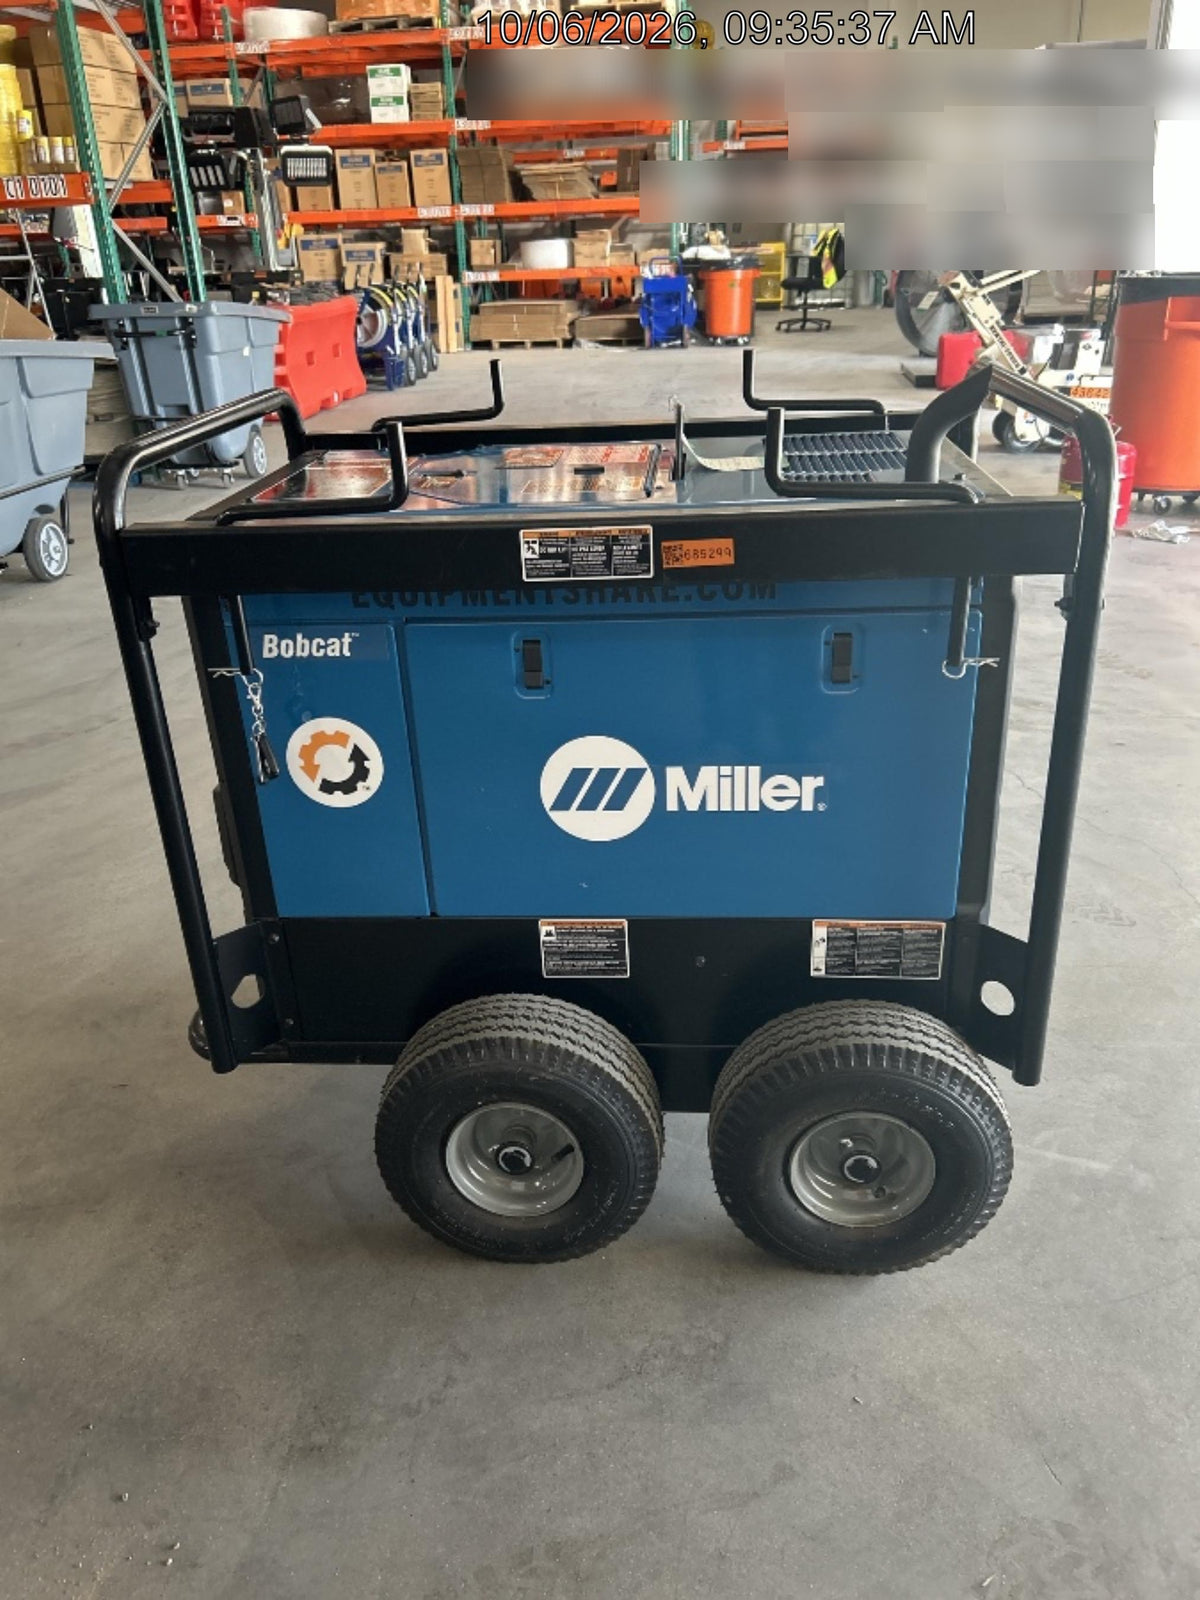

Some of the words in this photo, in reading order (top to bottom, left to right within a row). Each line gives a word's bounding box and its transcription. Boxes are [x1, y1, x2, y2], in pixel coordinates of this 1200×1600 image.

[684, 547, 732, 561] 685299
[352, 583, 777, 609] EQUIPMENTSHARE.COM
[262, 632, 353, 659] Bobcat
[666, 766, 825, 812] Miller
